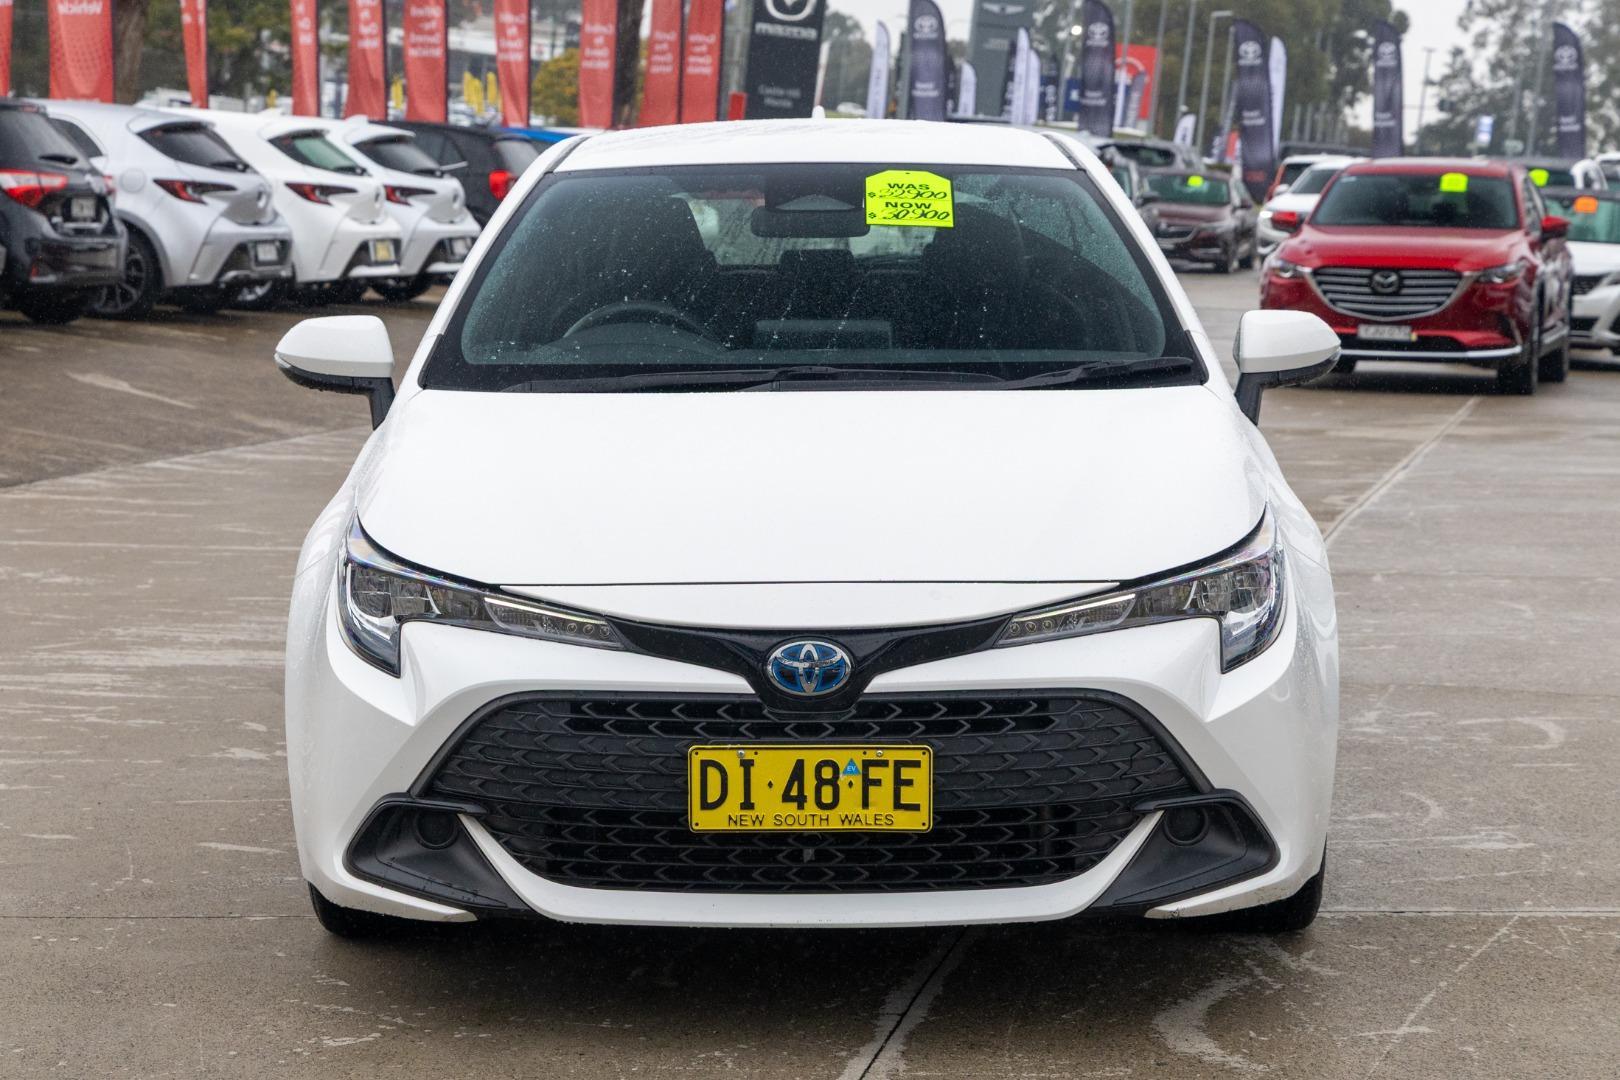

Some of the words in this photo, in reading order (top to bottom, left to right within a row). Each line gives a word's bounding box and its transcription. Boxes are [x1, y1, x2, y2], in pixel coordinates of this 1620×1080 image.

[885, 201, 932, 209] NOW
[728, 814, 765, 826] NEW
[773, 814, 829, 826] SOUTH
[840, 814, 894, 826] WALES
